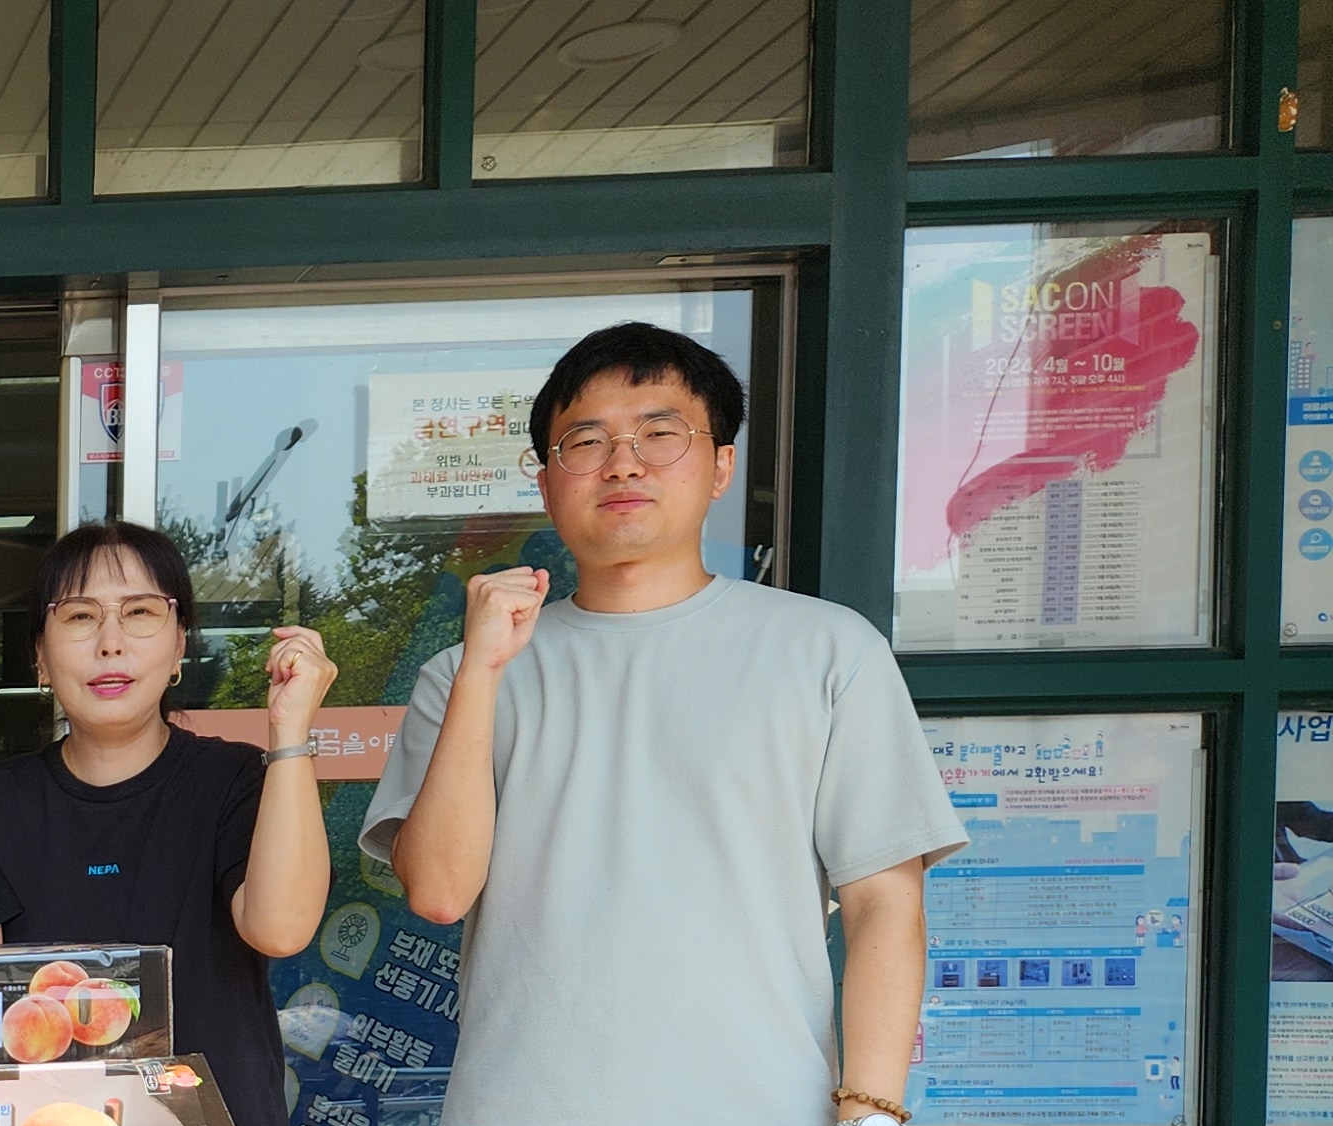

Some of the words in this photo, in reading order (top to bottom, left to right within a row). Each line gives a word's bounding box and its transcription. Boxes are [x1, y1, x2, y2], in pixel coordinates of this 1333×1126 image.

[1000, 283, 1060, 313] SAC
[1065, 282, 1114, 311] ON
[1000, 312, 1113, 344] SCREEN
[986, 358, 1038, 375] 2024.
[1043, 356, 1068, 373] 4월
[1092, 354, 1125, 371] 10월
[413, 399, 424, 412] 본
[431, 397, 471, 411] 청사는
[478, 396, 504, 409] 모든
[437, 455, 461, 467] 위반
[410, 471, 448, 484] 과태료
[455, 469, 507, 483] 10만원이
[427, 484, 491, 498] 부과됩니다
[929, 742, 954, 756] 대로
[960, 742, 1026, 766] 분리배출하고
[939, 768, 1018, 784] 순환가게에서
[1025, 766, 1102, 784] 교환받으세요!
[87, 863, 120, 875] NEPA
[390, 929, 437, 970] 부채
[374, 962, 441, 1011] 선풍기
[435, 990, 460, 1024] 사
[346, 1013, 434, 1071] 외부활동
[333, 1043, 398, 1094] 줄이기
